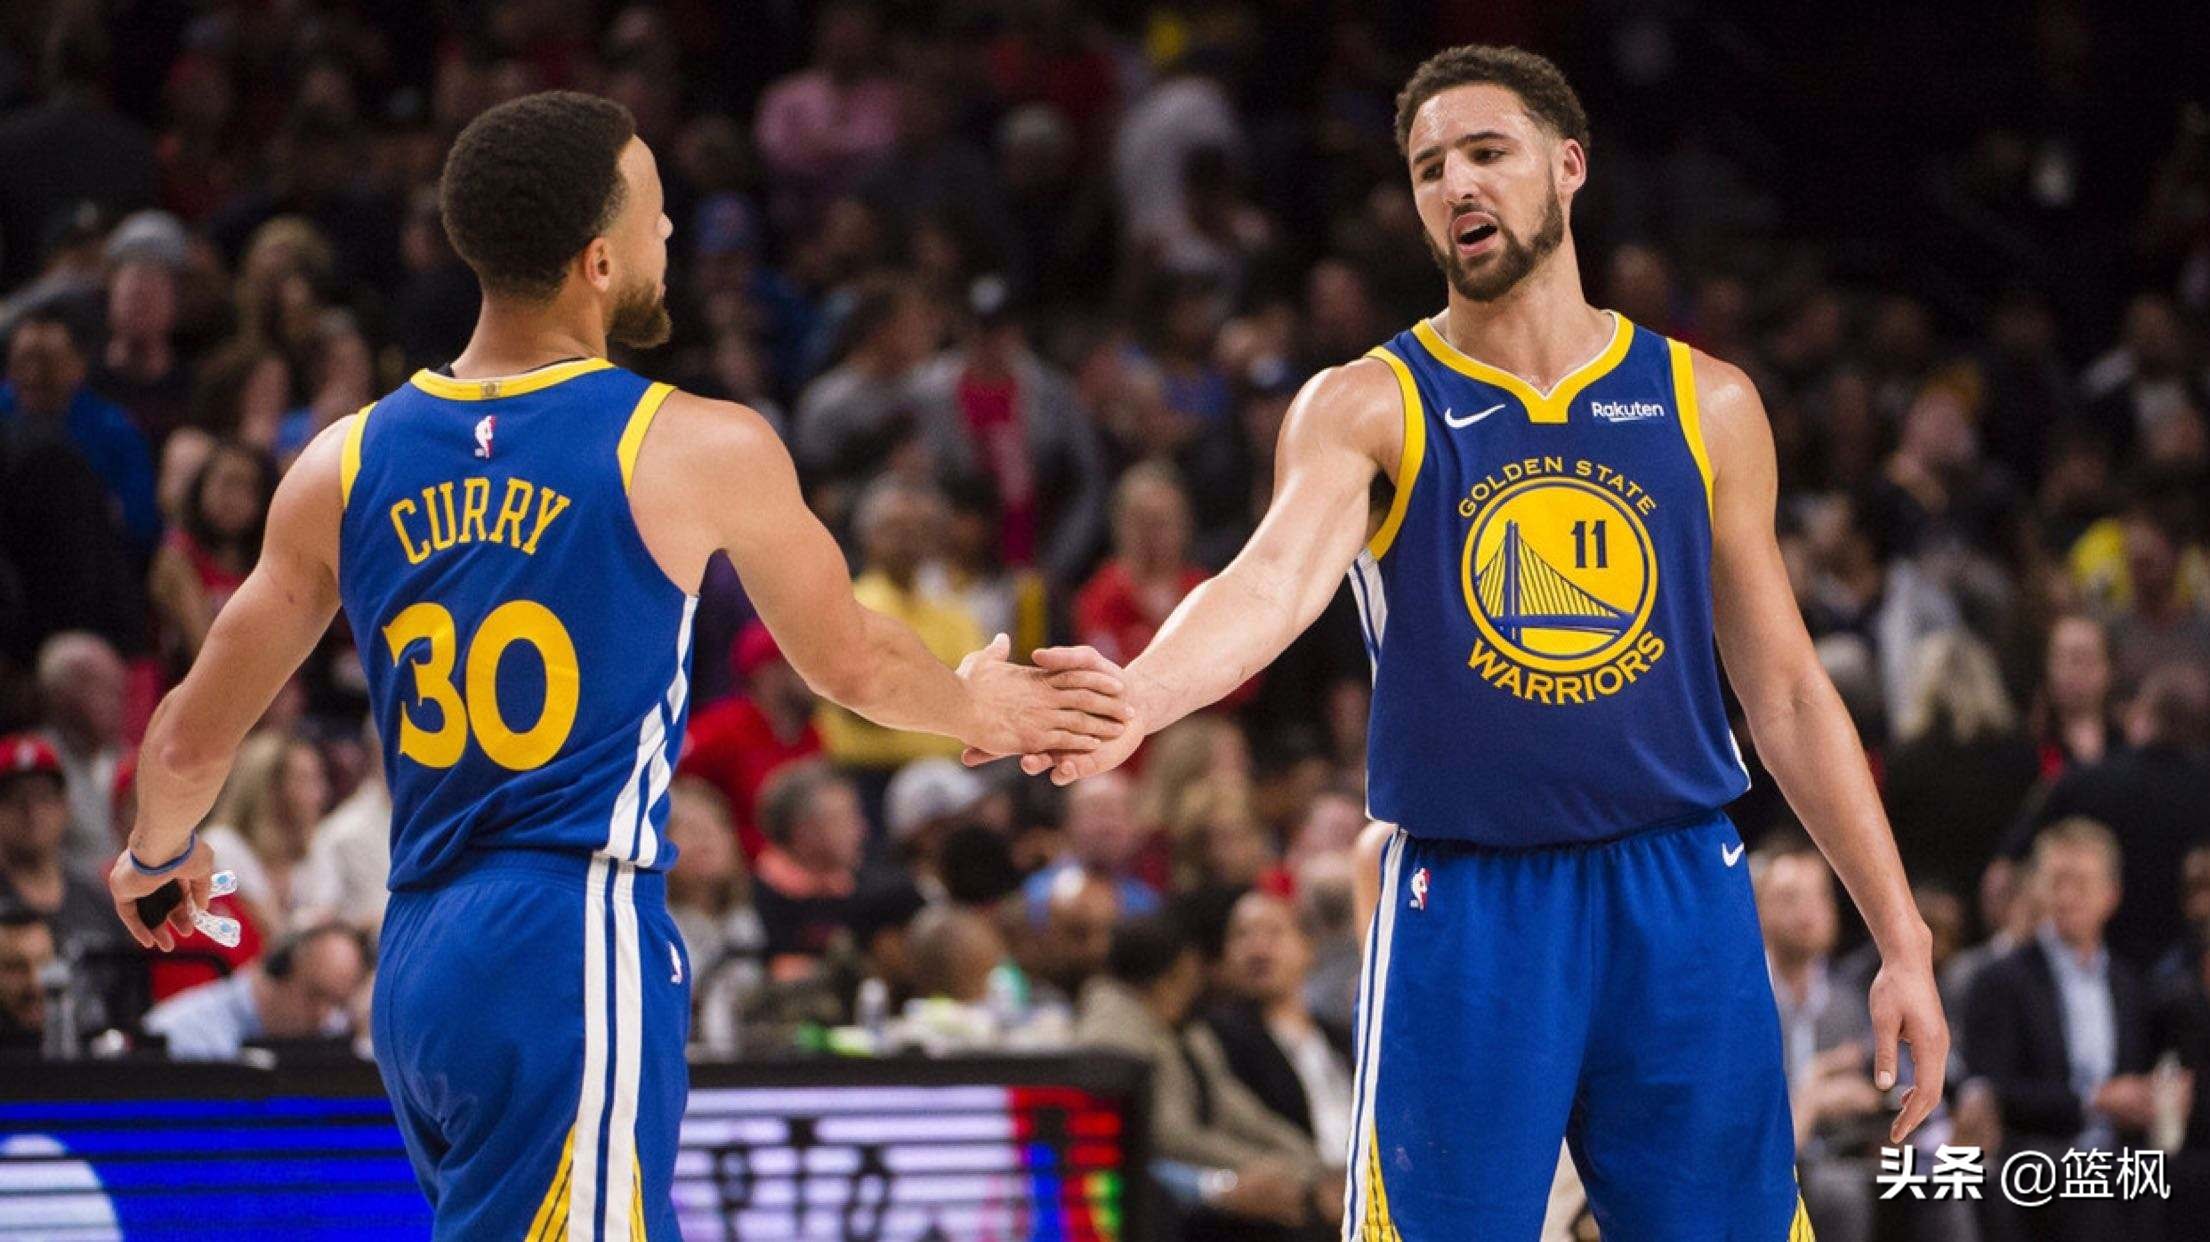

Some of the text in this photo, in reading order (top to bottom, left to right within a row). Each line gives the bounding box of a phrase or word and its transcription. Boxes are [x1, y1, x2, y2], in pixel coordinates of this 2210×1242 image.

[1591, 401, 1665, 418] Rakuten
[389, 476, 572, 565] CURRY
[1458, 456, 1657, 518] GOLDEN STATE
[1570, 520, 1608, 569] 11
[381, 599, 580, 772] 30
[1466, 630, 1667, 705] WARRIORS
